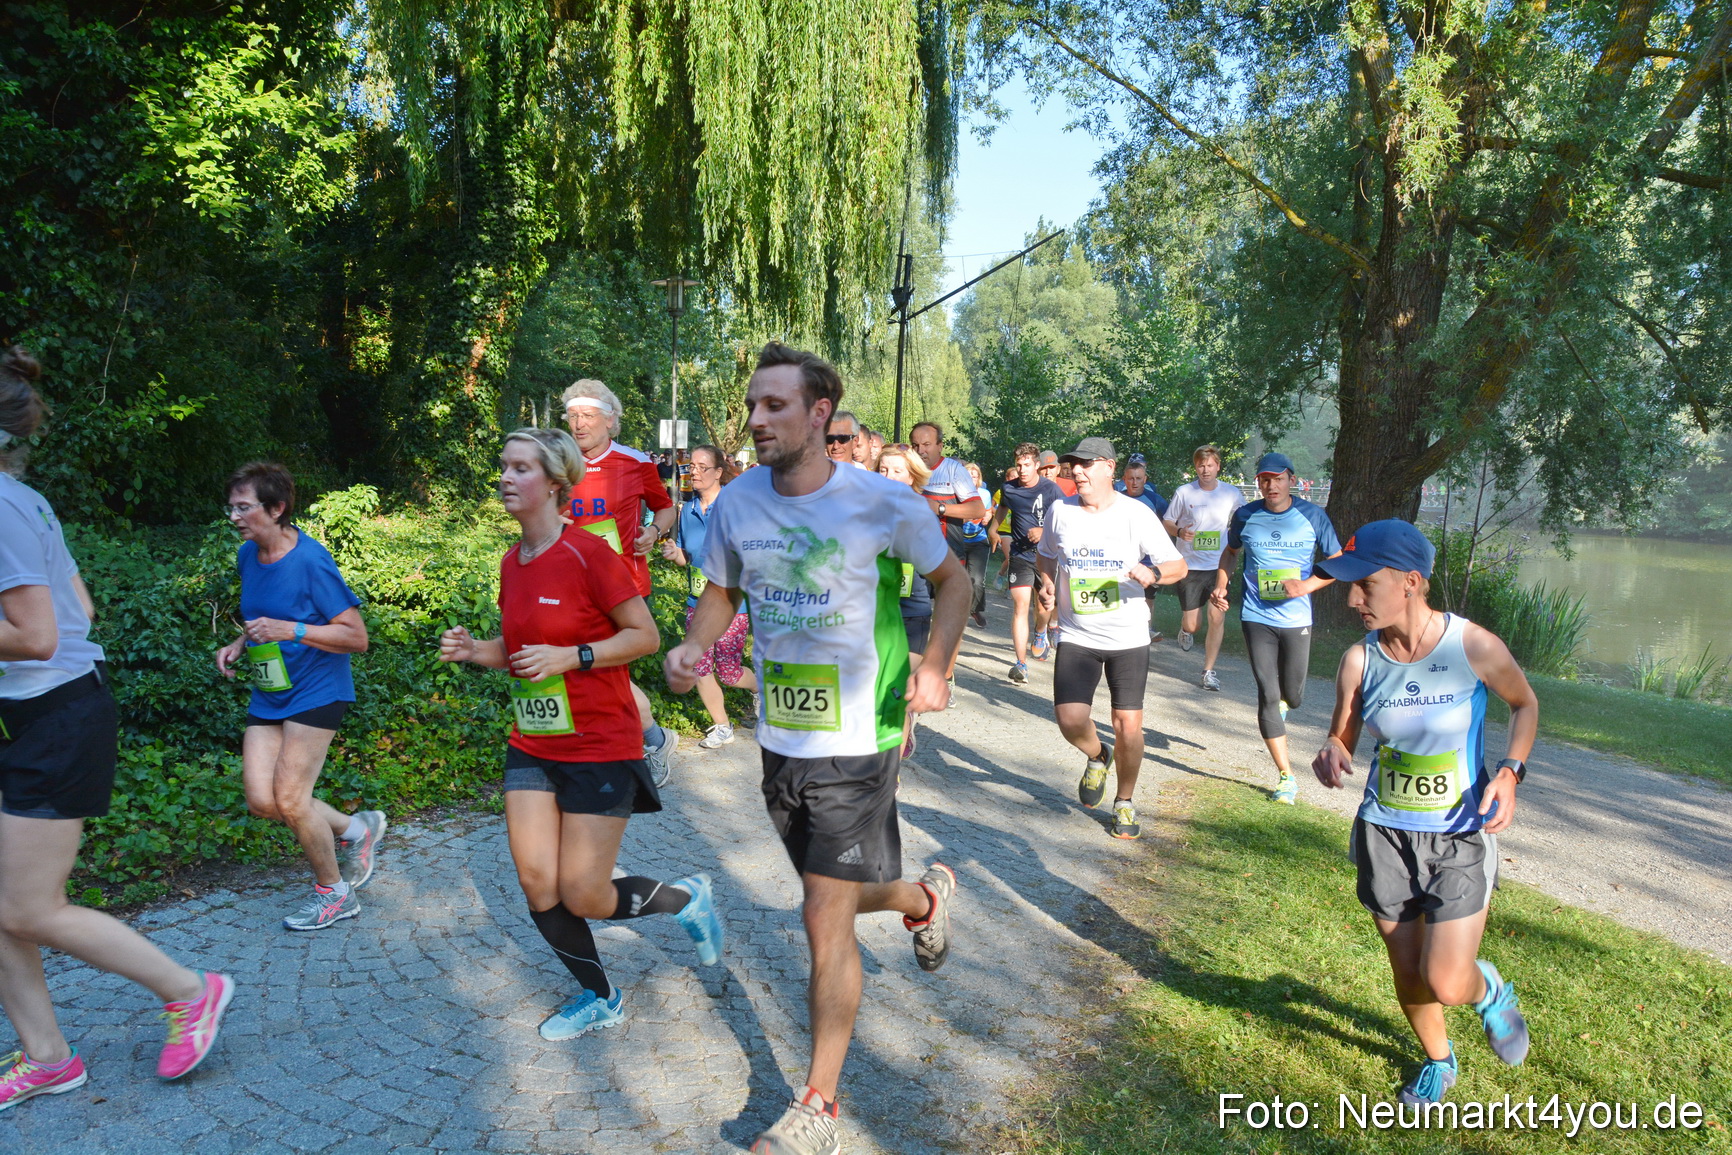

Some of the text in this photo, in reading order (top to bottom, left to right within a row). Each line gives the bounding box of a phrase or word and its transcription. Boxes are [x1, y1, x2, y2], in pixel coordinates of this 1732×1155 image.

[571, 498, 613, 517] G.B.
[1197, 538, 1217, 546] 1791
[1067, 558, 1124, 569] Engineering
[764, 587, 831, 608] Laufend
[1080, 590, 1109, 605] 973
[759, 608, 845, 632] erfolgreich
[517, 698, 559, 719] 1499
[771, 685, 828, 712] 1025
[1378, 694, 1454, 709] SCHABMÜLLER
[1387, 770, 1448, 796] 1768
